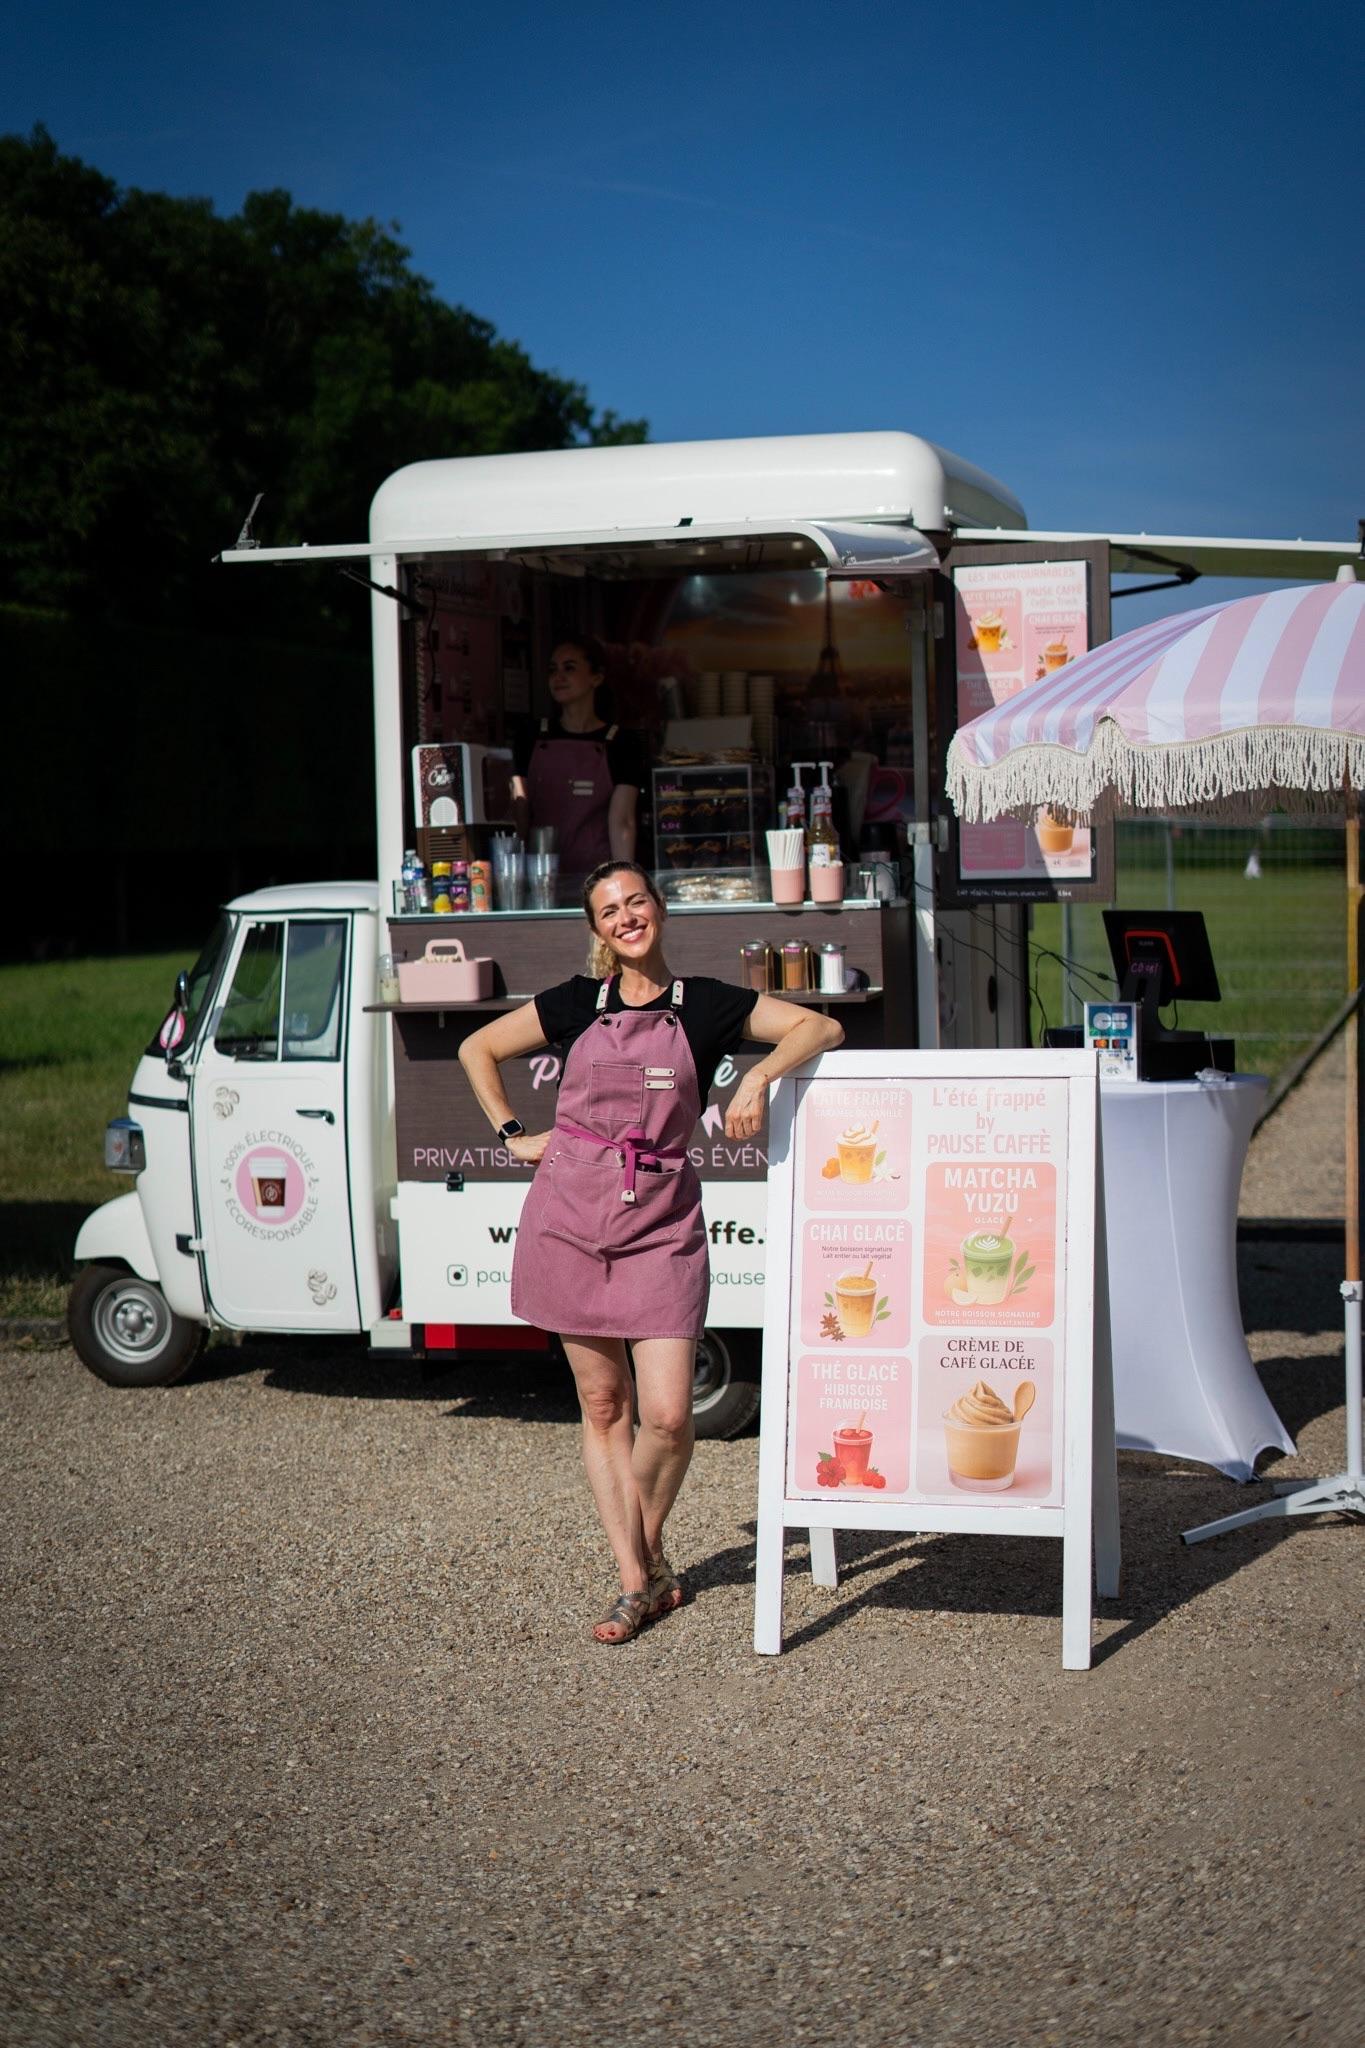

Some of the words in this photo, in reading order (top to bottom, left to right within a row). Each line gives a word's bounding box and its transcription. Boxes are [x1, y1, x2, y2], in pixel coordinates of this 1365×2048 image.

[986, 1087, 1046, 1112] frappé
[976, 1112, 995, 1134] by
[927, 1134, 986, 1154] PAUSE
[413, 1147, 536, 1167] PRIVATISE
[711, 1143, 769, 1167] ÉVÉN
[944, 1167, 1037, 1189] MATCHA
[810, 1224, 848, 1241] CHAI
[864, 1246, 893, 1254] signature
[947, 1336, 1000, 1352] CRÈME
[1005, 1341, 1025, 1353] DE
[811, 1360, 841, 1380] THÉ
[940, 1354, 976, 1369] CAFÉ
[980, 1355, 1035, 1370] GLACÉE
[824, 1384, 883, 1397] HIBISCUS
[819, 1397, 888, 1410] FRAMBOISE
